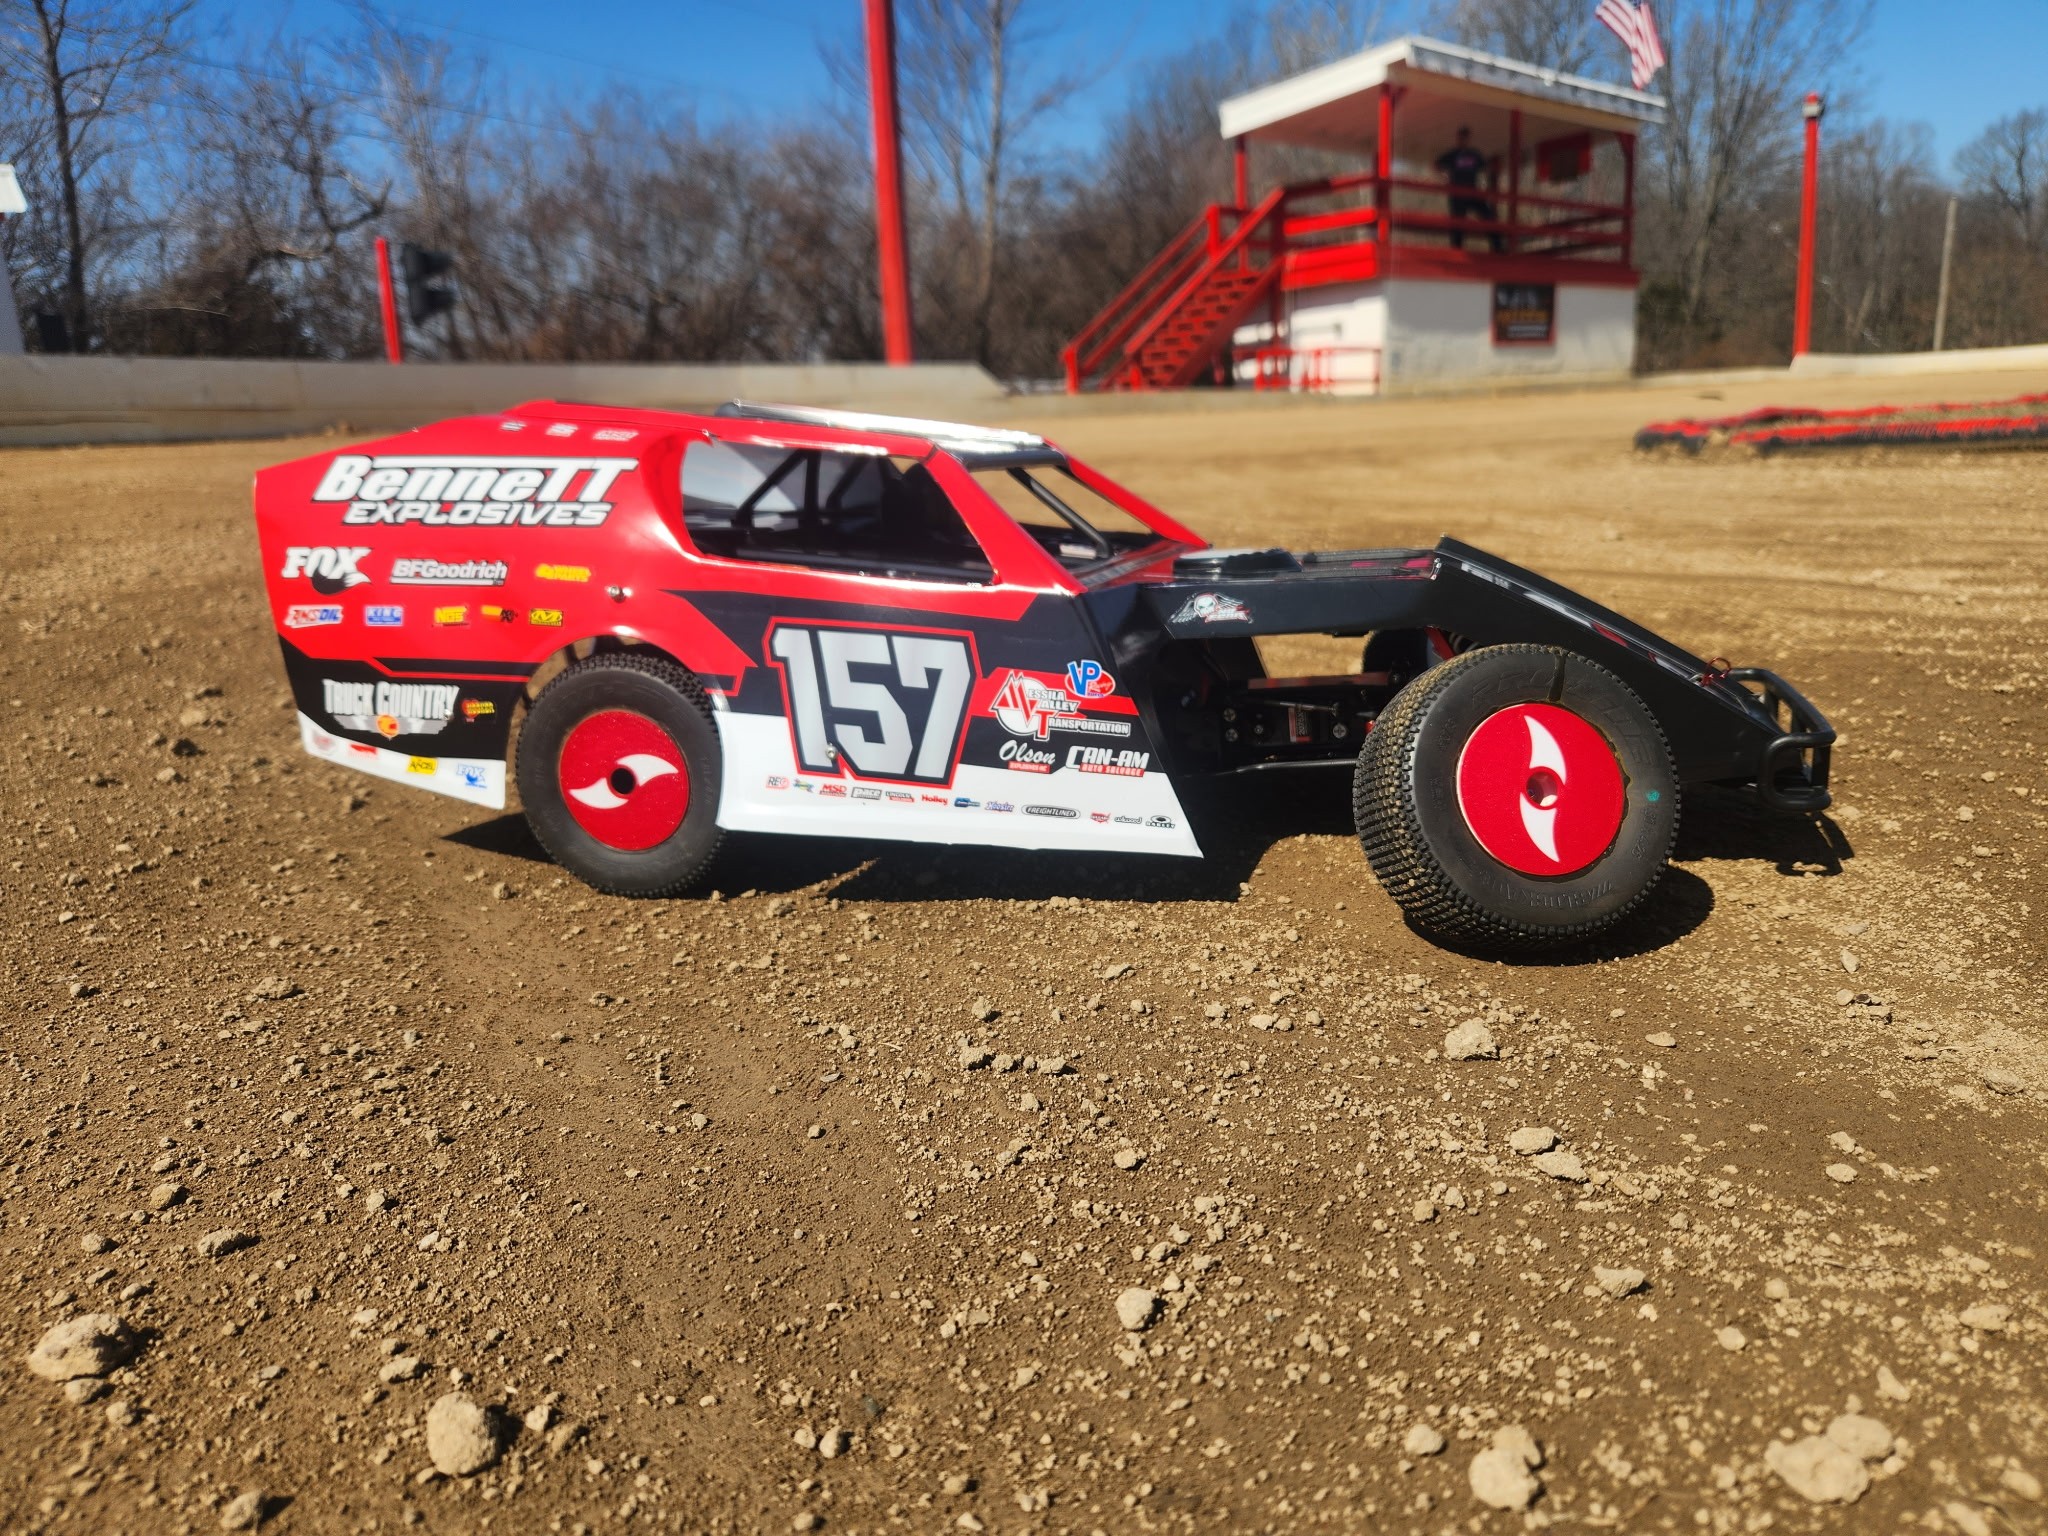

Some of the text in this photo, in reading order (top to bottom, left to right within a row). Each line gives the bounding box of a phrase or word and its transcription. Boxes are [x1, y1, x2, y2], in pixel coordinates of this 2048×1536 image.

[343, 501, 613, 525] EXPLOSIVES
[282, 547, 371, 583] FOX
[391, 559, 508, 580] BFGoodrich
[1069, 660, 1102, 696] VP
[323, 679, 459, 720] TRUCK COUNTRY
[773, 628, 971, 779] 157
[1035, 709, 1130, 738] TRANSPORTATION
[999, 739, 1055, 765] Olson
[1066, 746, 1149, 769] CAN-AM
[822, 784, 847, 793] MSD
[922, 793, 948, 806] Holley
[1026, 806, 1075, 817] FREIGHTLINER
